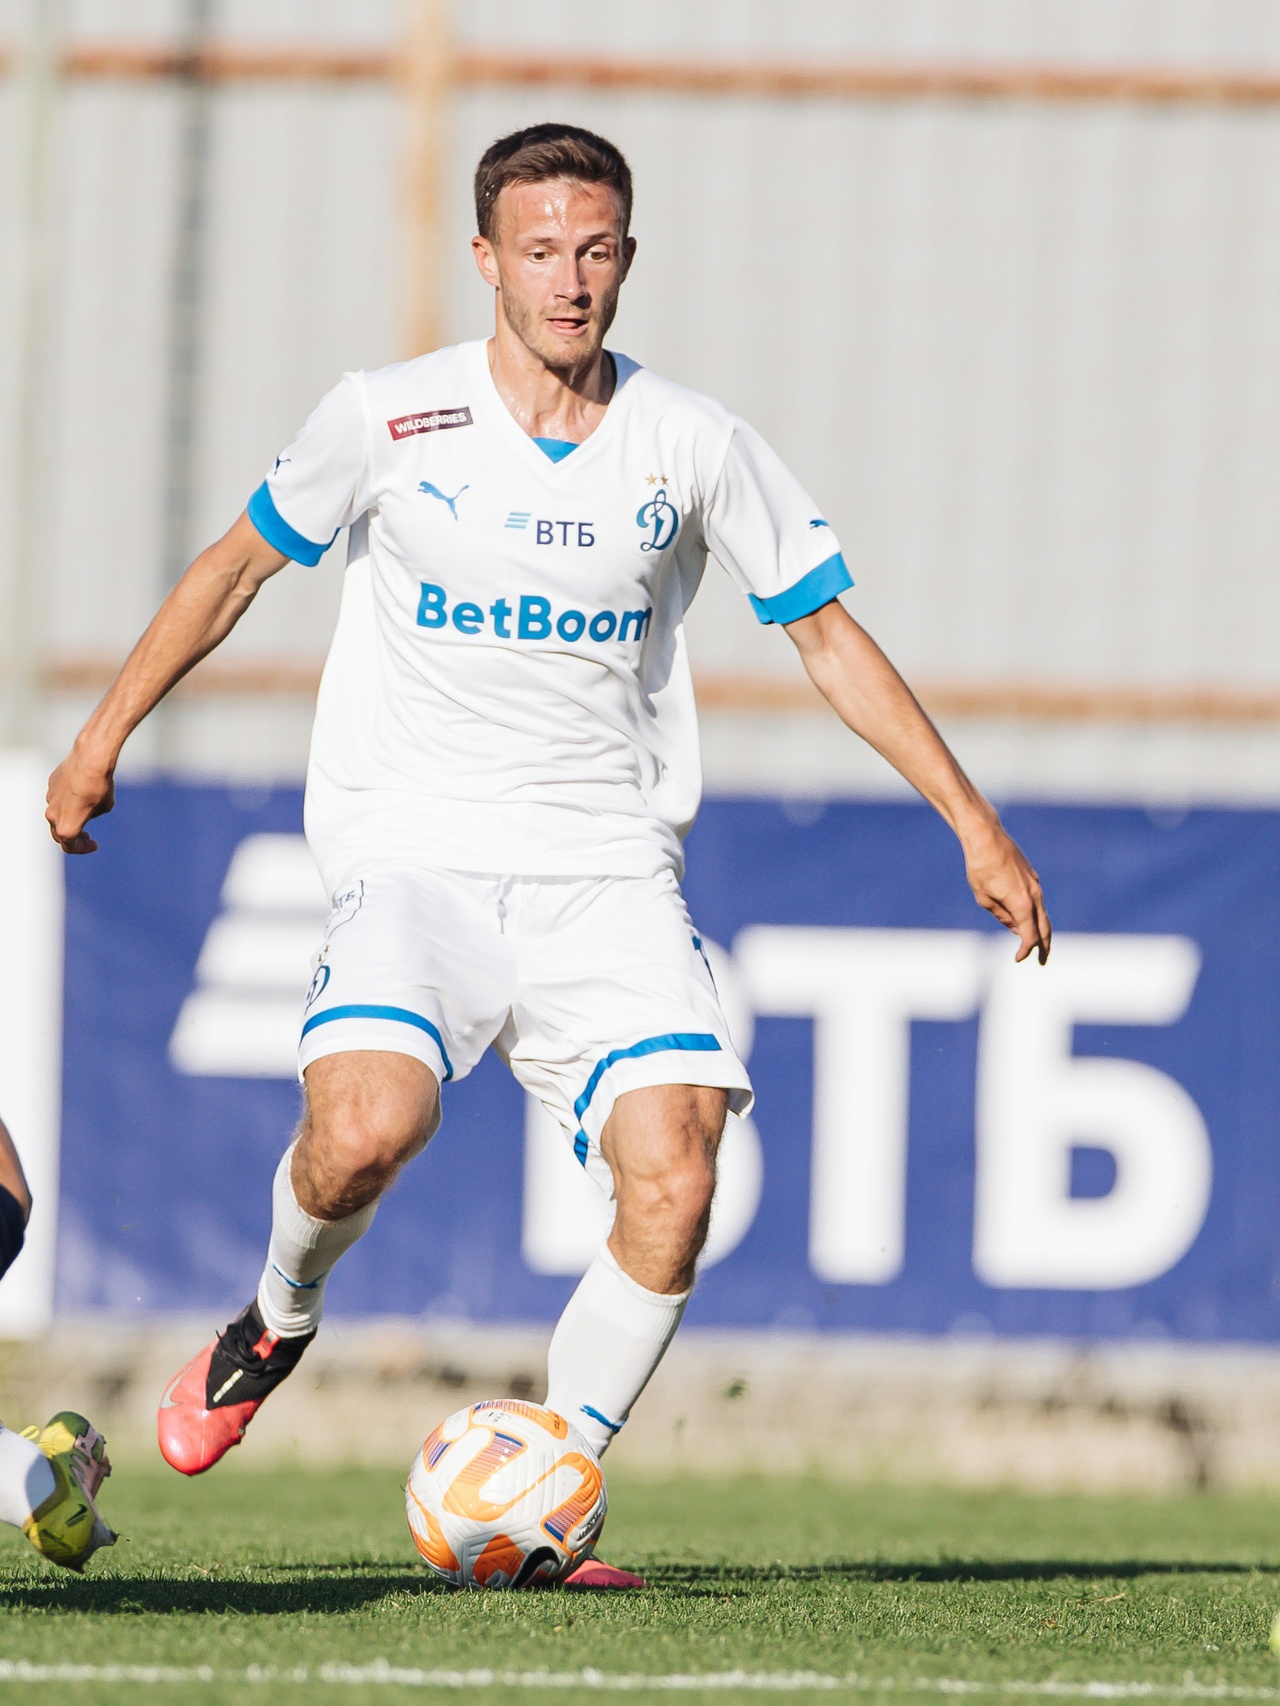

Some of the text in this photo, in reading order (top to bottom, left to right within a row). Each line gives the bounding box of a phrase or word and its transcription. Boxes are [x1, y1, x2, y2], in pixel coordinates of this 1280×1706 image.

[394, 412, 467, 434] WILDBERRIES
[535, 519, 595, 548] ВТБ
[416, 581, 653, 642] BetBoom
